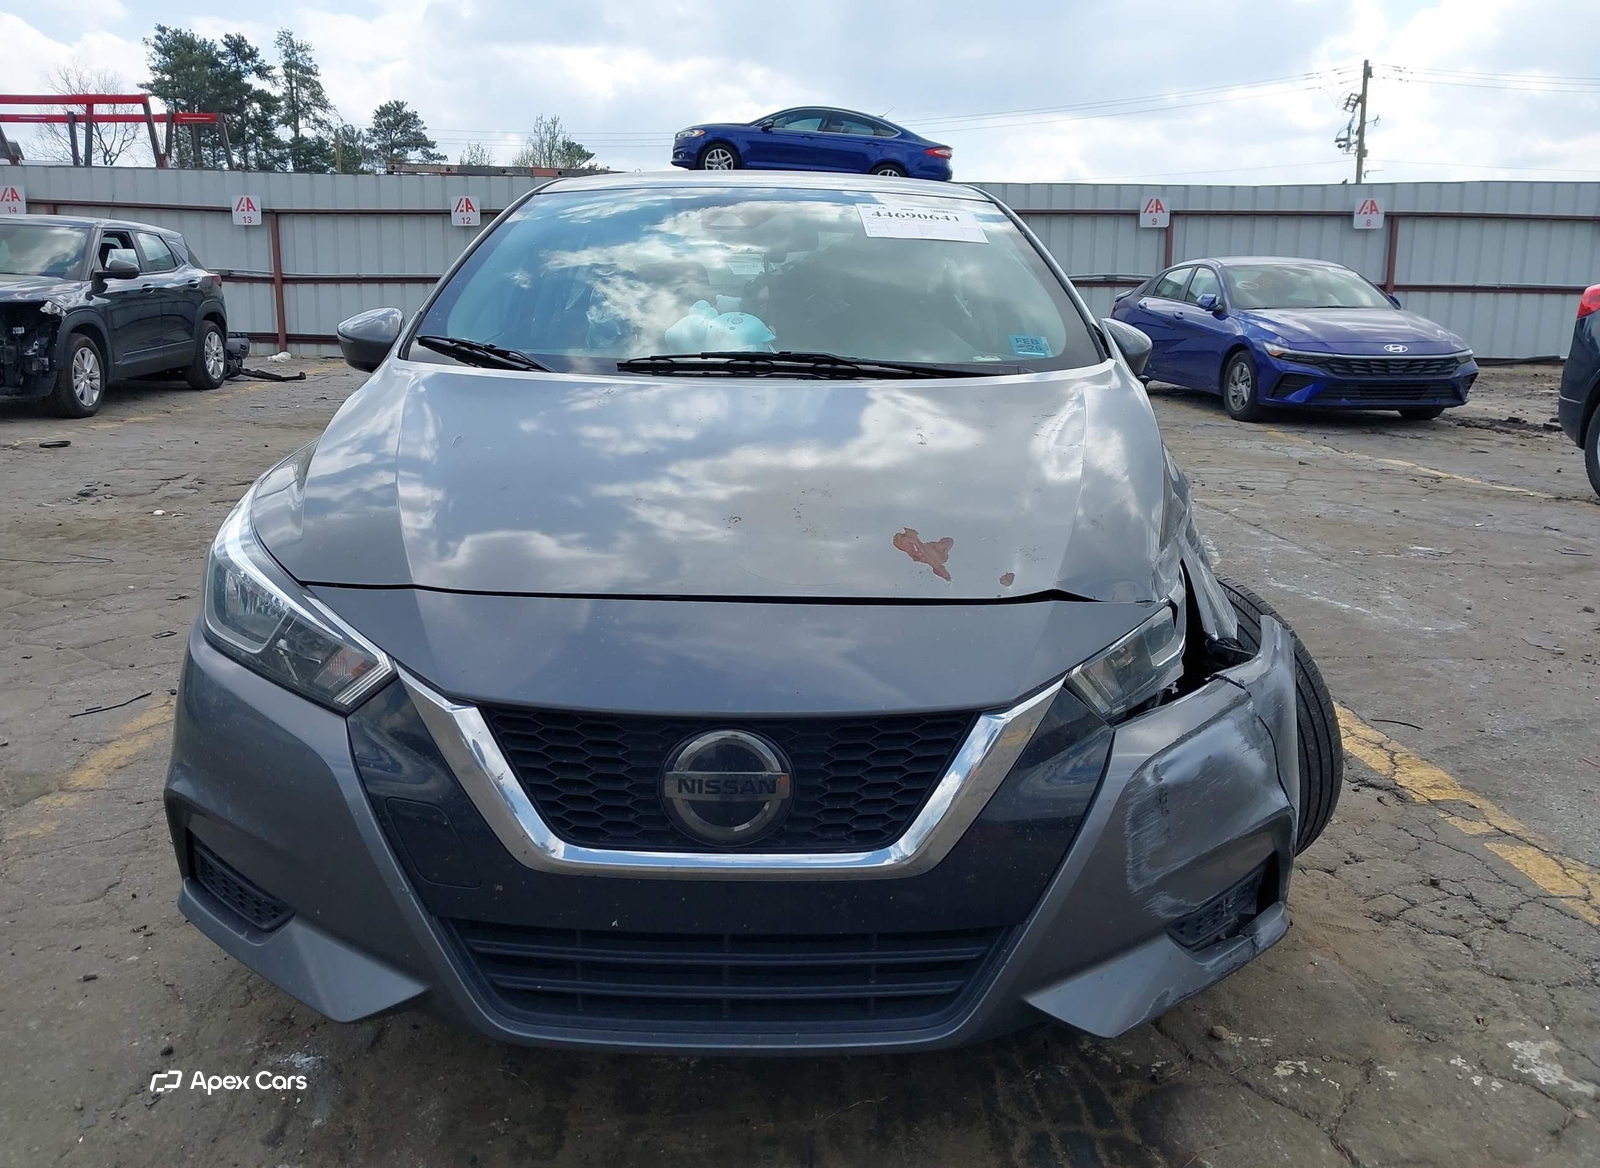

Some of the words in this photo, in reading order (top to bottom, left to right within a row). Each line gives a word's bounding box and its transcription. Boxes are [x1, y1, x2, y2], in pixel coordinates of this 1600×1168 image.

[871, 211, 960, 222] 44690641
[461, 217, 471, 225] 12
[1151, 217, 1158, 226] 9
[1365, 219, 1372, 227] 8
[1015, 337, 1040, 345] FEB
[677, 778, 777, 794] NISSAN
